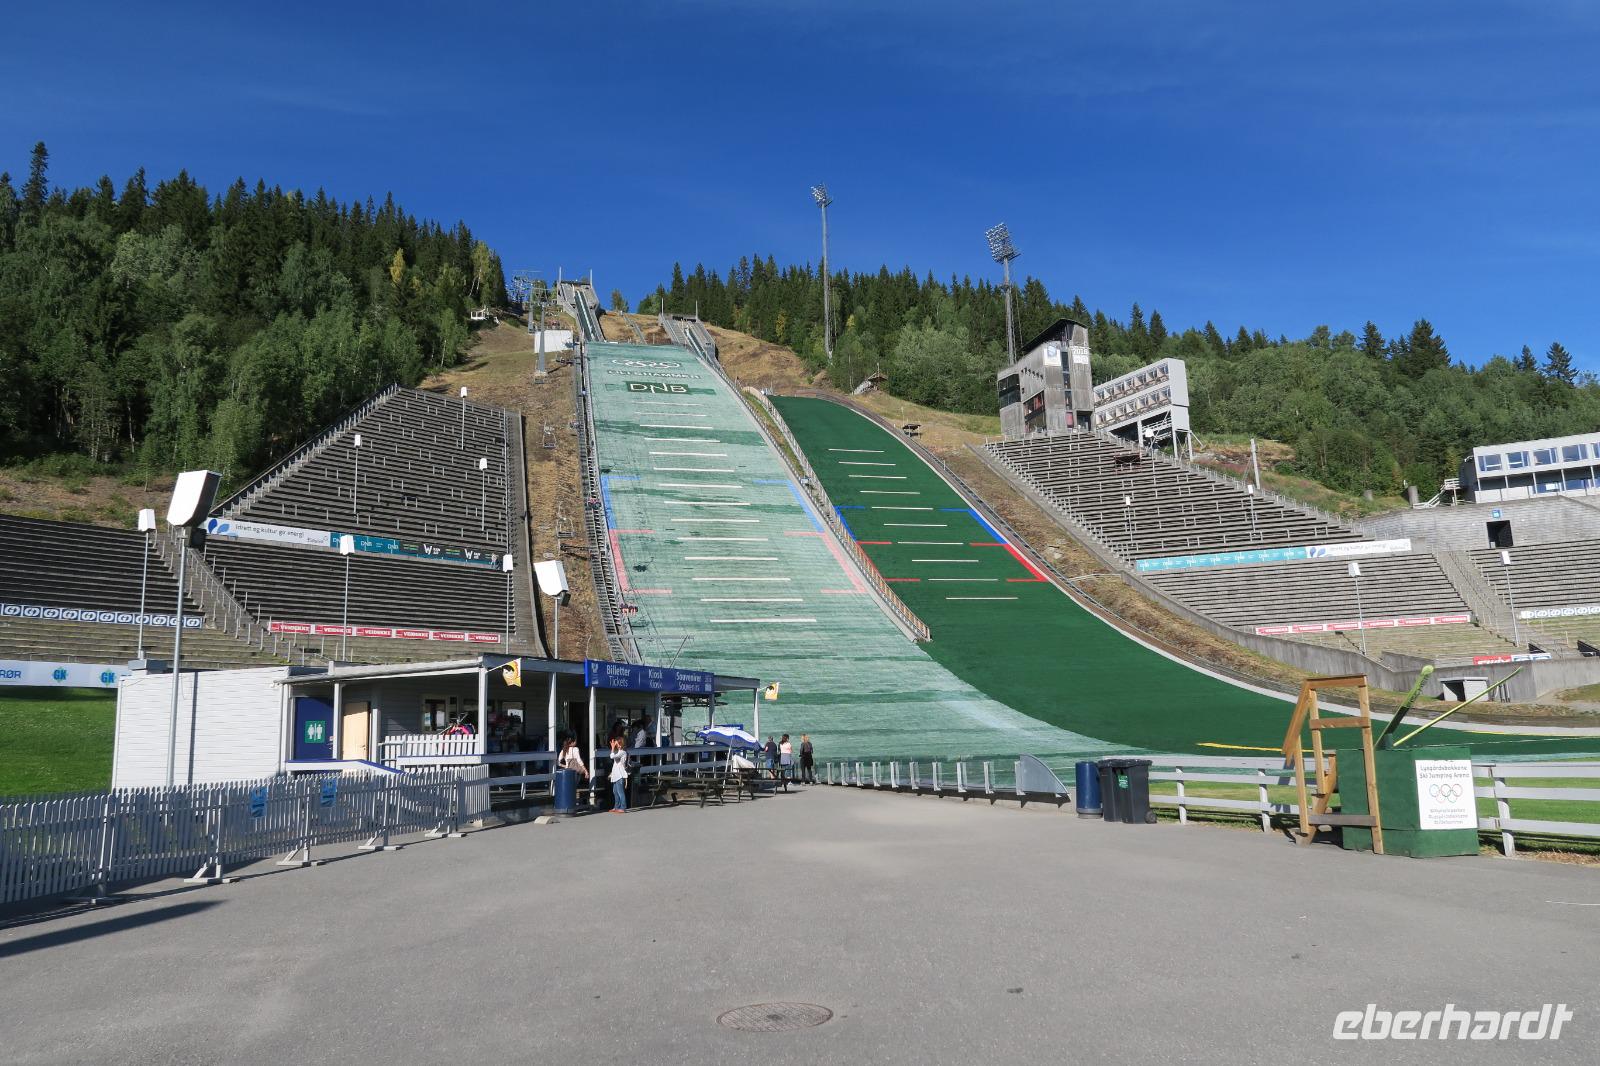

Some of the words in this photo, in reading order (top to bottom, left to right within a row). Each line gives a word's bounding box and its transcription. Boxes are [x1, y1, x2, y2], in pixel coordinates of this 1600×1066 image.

[630, 382, 687, 394] DNB
[53, 669, 66, 680] GK
[607, 664, 631, 676] Billetter
[648, 669, 663, 678] Kiosk
[101, 672, 115, 683] GK
[609, 676, 628, 687] Tickets
[650, 680, 663, 688] Kiosk
